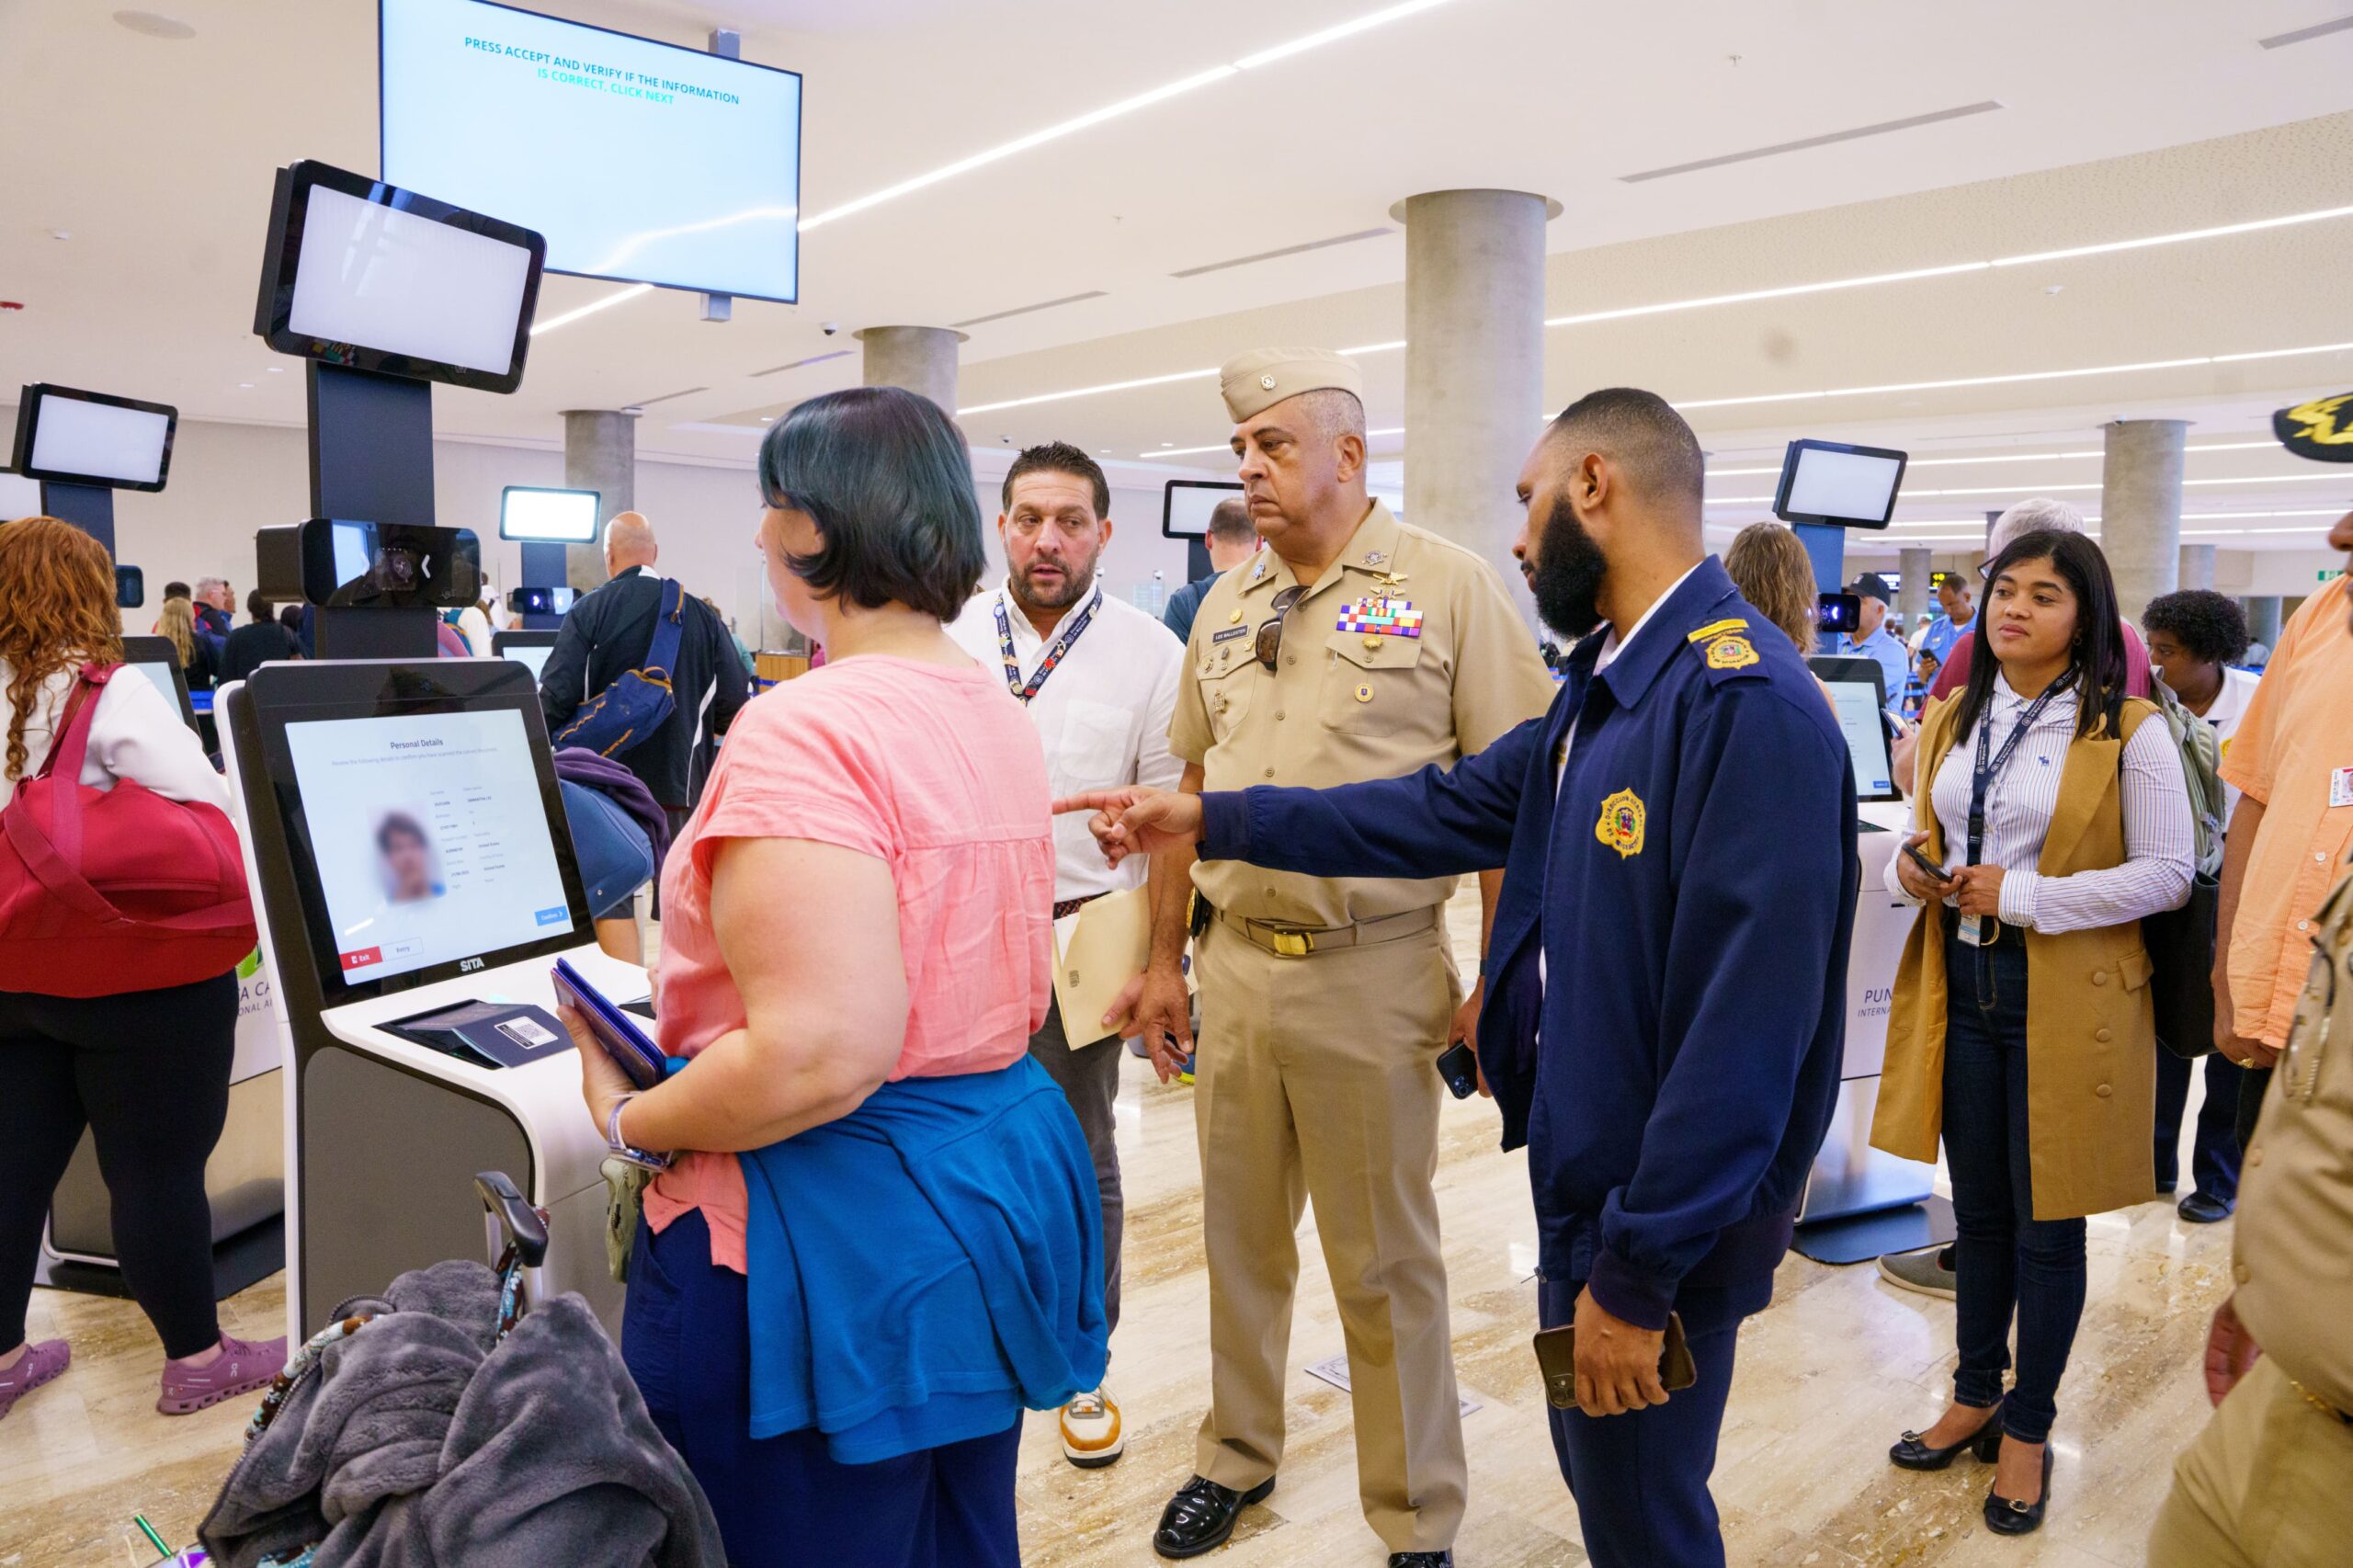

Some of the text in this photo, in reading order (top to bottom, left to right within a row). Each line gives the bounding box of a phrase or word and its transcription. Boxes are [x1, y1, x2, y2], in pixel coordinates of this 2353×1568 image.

[465, 37, 739, 105] PRESS ACCEPT AND VERIFY IF THE INFORMATION
[538, 68, 549, 79] IS
[610, 83, 642, 97] CLICK
[645, 90, 675, 104] NEXT
[390, 738, 444, 749] Personal Details
[460, 957, 485, 971] SITA
